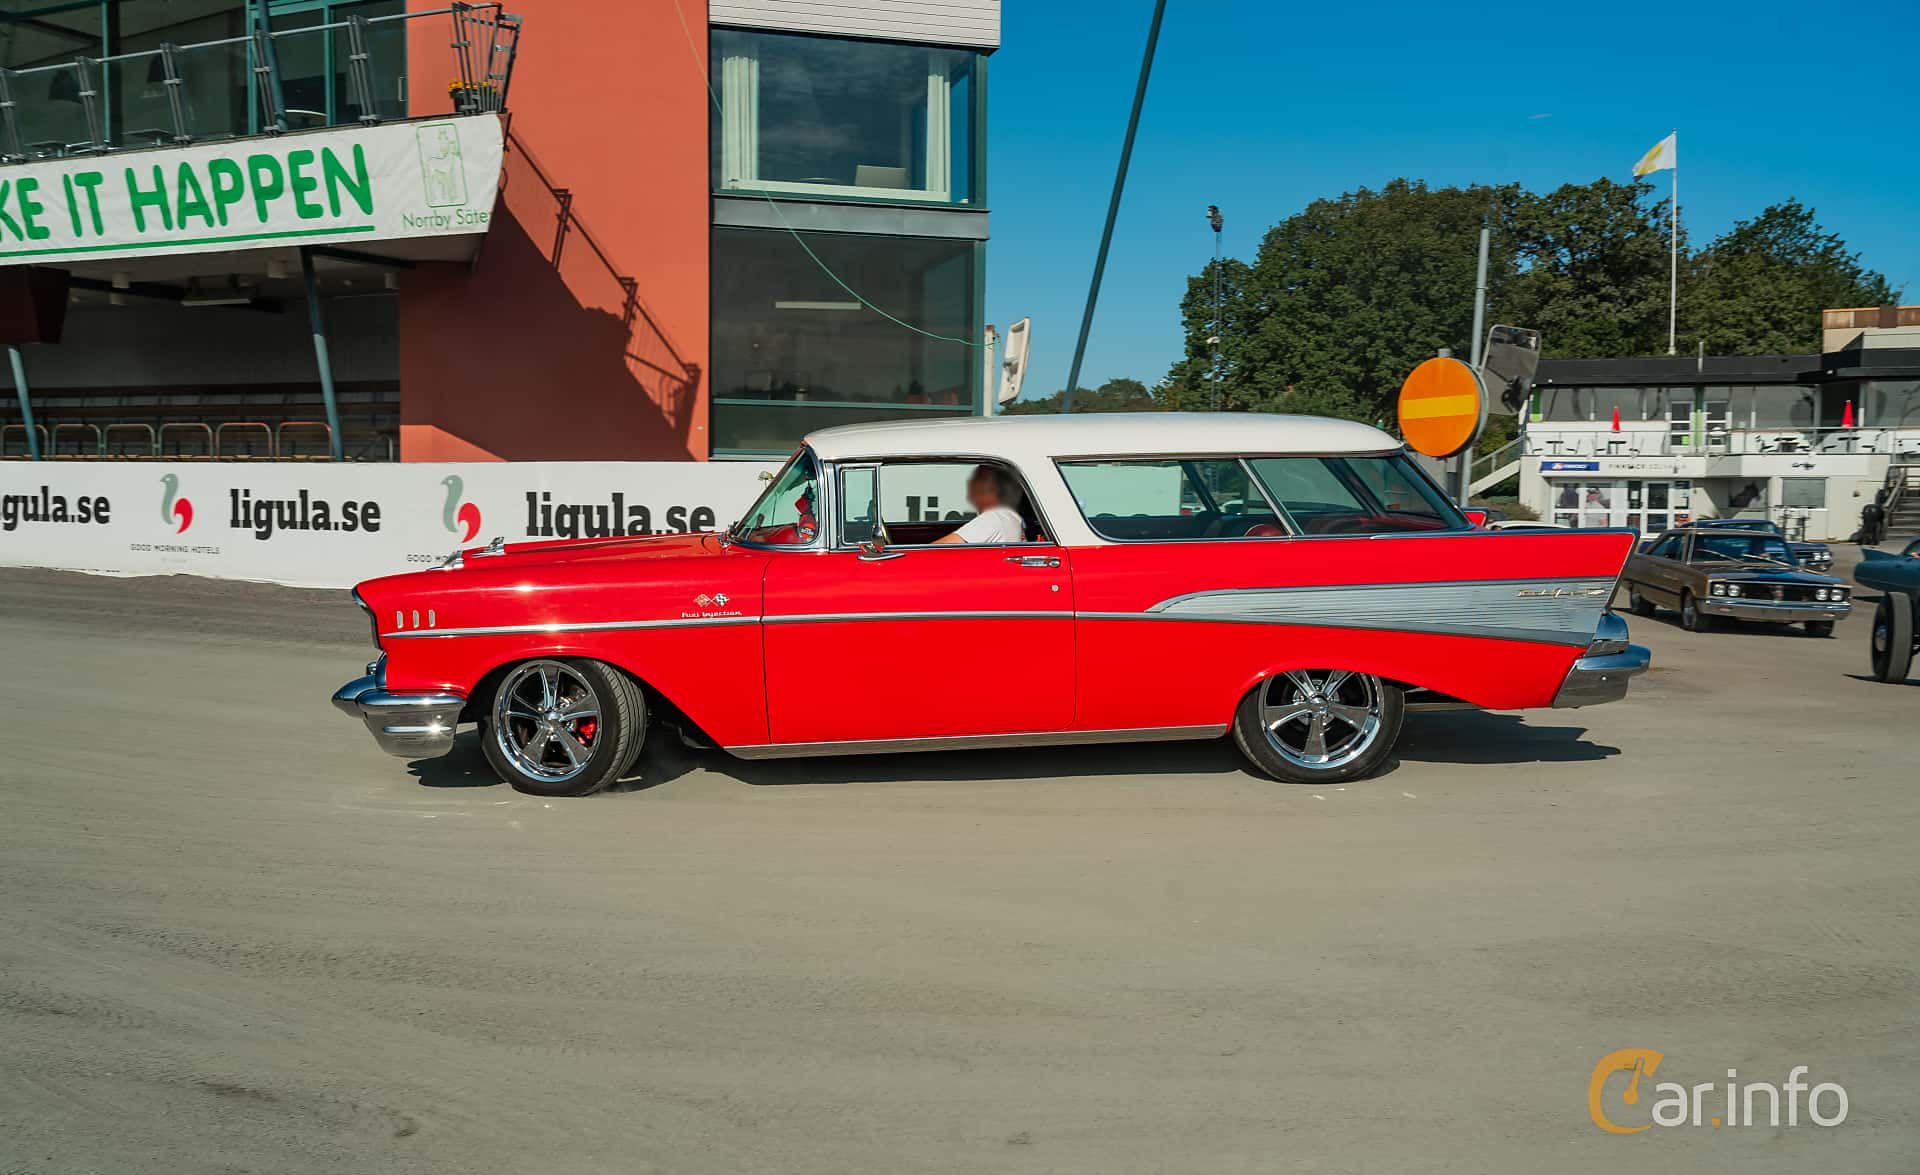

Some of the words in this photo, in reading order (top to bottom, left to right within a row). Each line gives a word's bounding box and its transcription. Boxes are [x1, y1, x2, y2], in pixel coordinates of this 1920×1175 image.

[62, 170, 105, 238] IT
[124, 143, 375, 234] HAPPEN
[401, 208, 451, 230] Norrby
[0, 485, 111, 532] gula.se
[230, 488, 381, 541] ligula.se
[129, 543, 152, 552] GOOD
